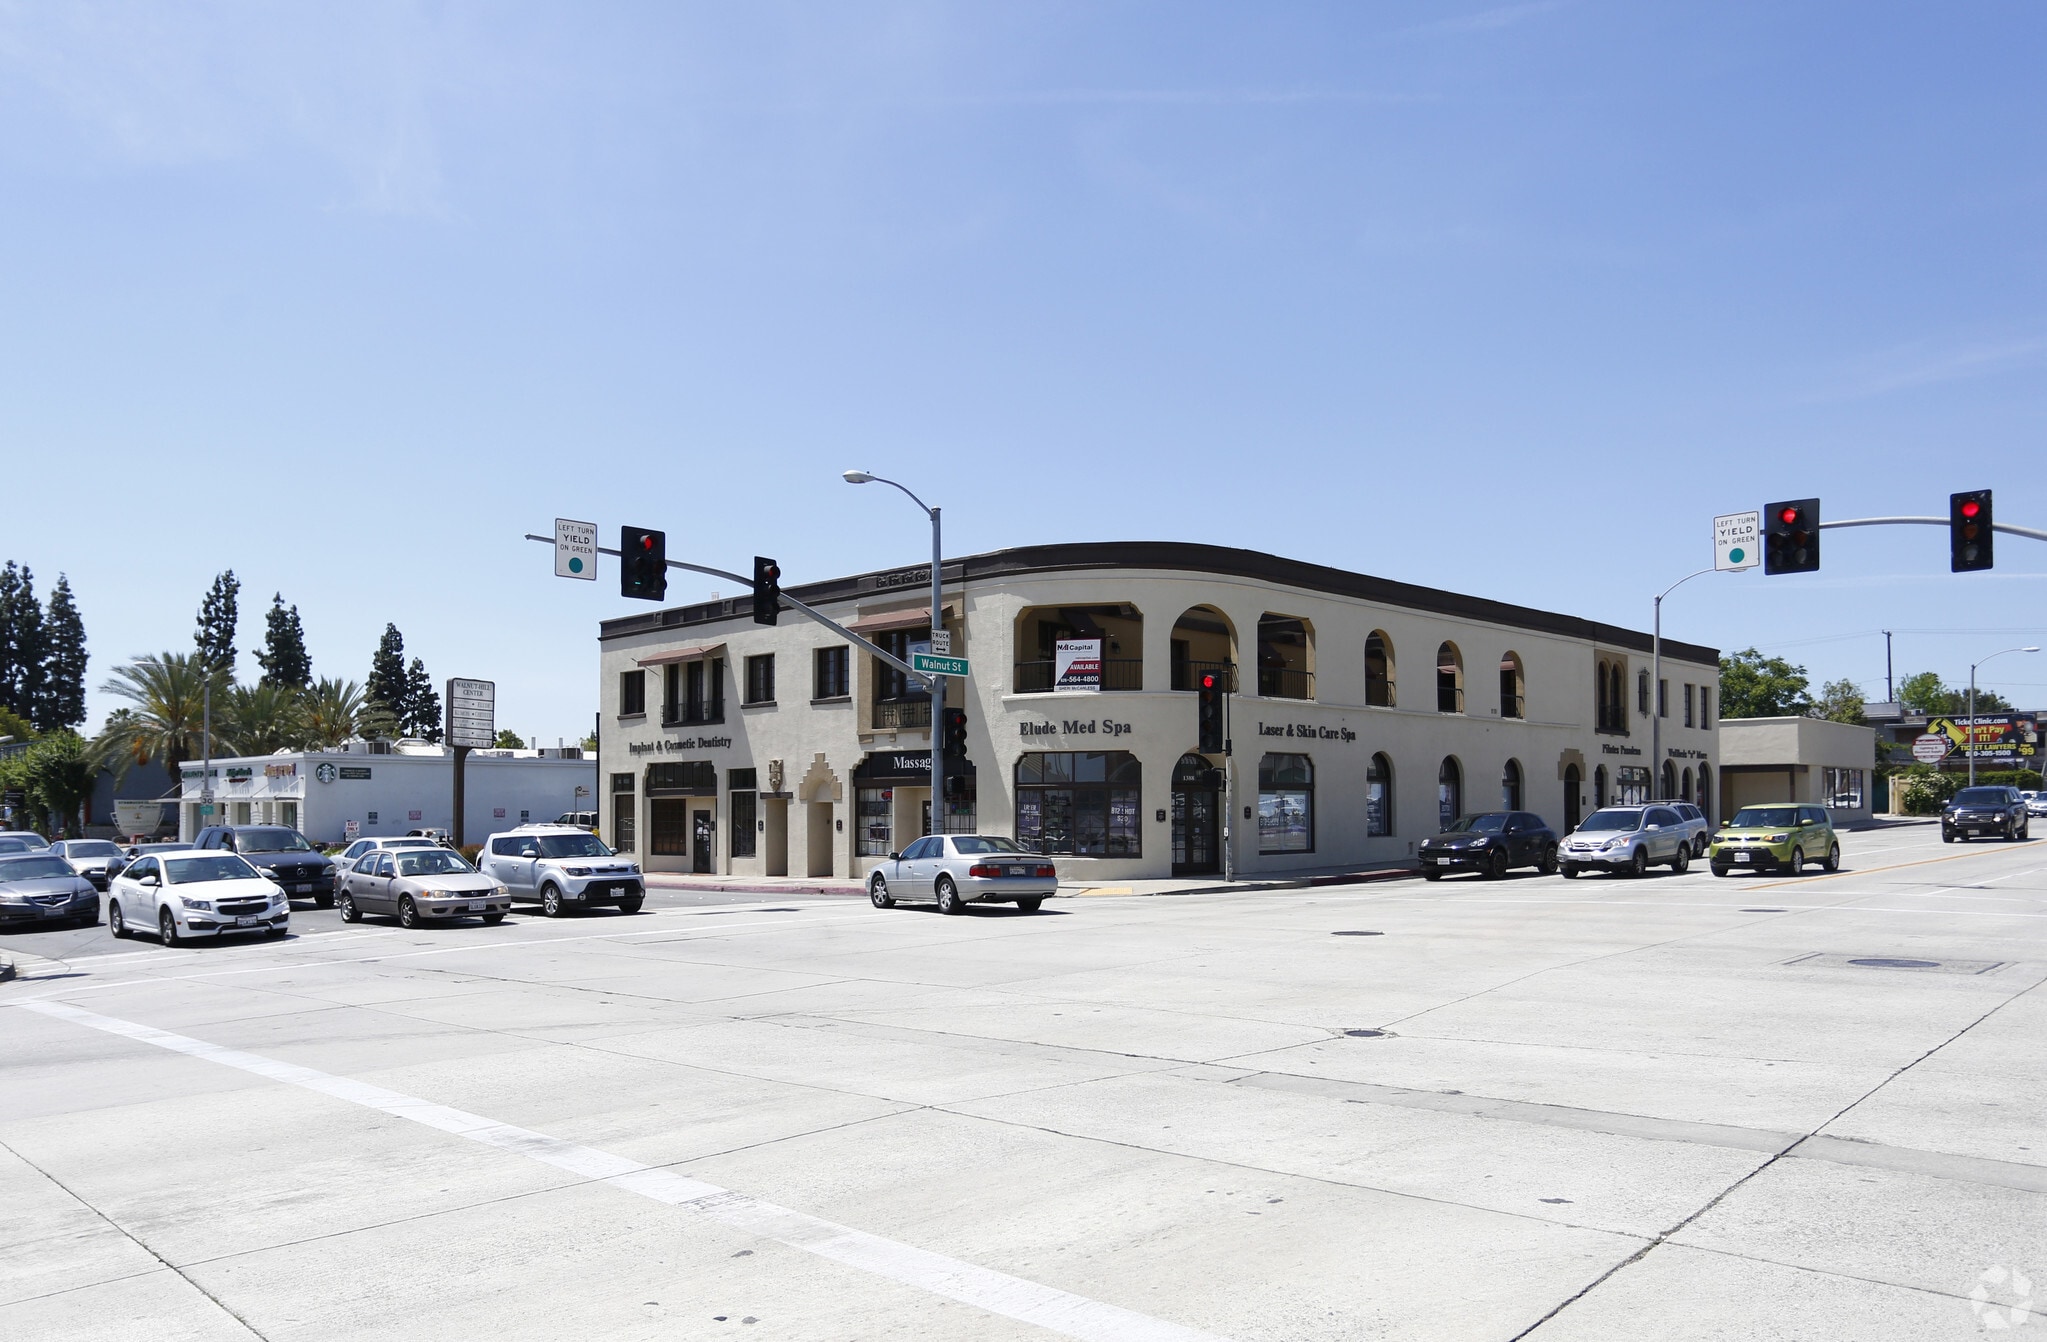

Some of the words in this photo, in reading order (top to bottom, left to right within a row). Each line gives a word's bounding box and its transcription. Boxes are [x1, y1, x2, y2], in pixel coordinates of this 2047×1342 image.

[1716, 520, 1733, 528] LEFT
[1737, 516, 1756, 524] TURN
[558, 524, 574, 532] LEFT
[577, 526, 594, 535] TURN
[1719, 525, 1753, 537] YIELD
[563, 533, 590, 545] YIELD
[1732, 535, 1755, 544] GREEN
[572, 545, 593, 554] GREEN
[932, 639, 949, 647] ROUTE
[921, 658, 951, 671] Walnut
[951, 661, 962, 672] St
[463, 689, 484, 697] CENTER
[1954, 717, 2009, 726] TickeClinic.com
[1019, 721, 1057, 736] Elude
[1062, 720, 1097, 735] Med
[1102, 719, 1132, 737] Spa
[1258, 721, 1285, 736] Laser
[1286, 723, 1294, 737] &
[1296, 724, 1317, 738] Skin
[1319, 726, 1339, 740] Care
[1340, 727, 1356, 743] Spa
[1965, 726, 1987, 734] Dn't
[1989, 725, 2005, 734] Pay
[1979, 734, 1991, 742] IT!
[629, 742, 654, 755] Implant
[656, 740, 663, 752] &
[664, 738, 696, 751] Cosmetic
[698, 736, 732, 749] Dentistry
[893, 756, 932, 770] Massag
